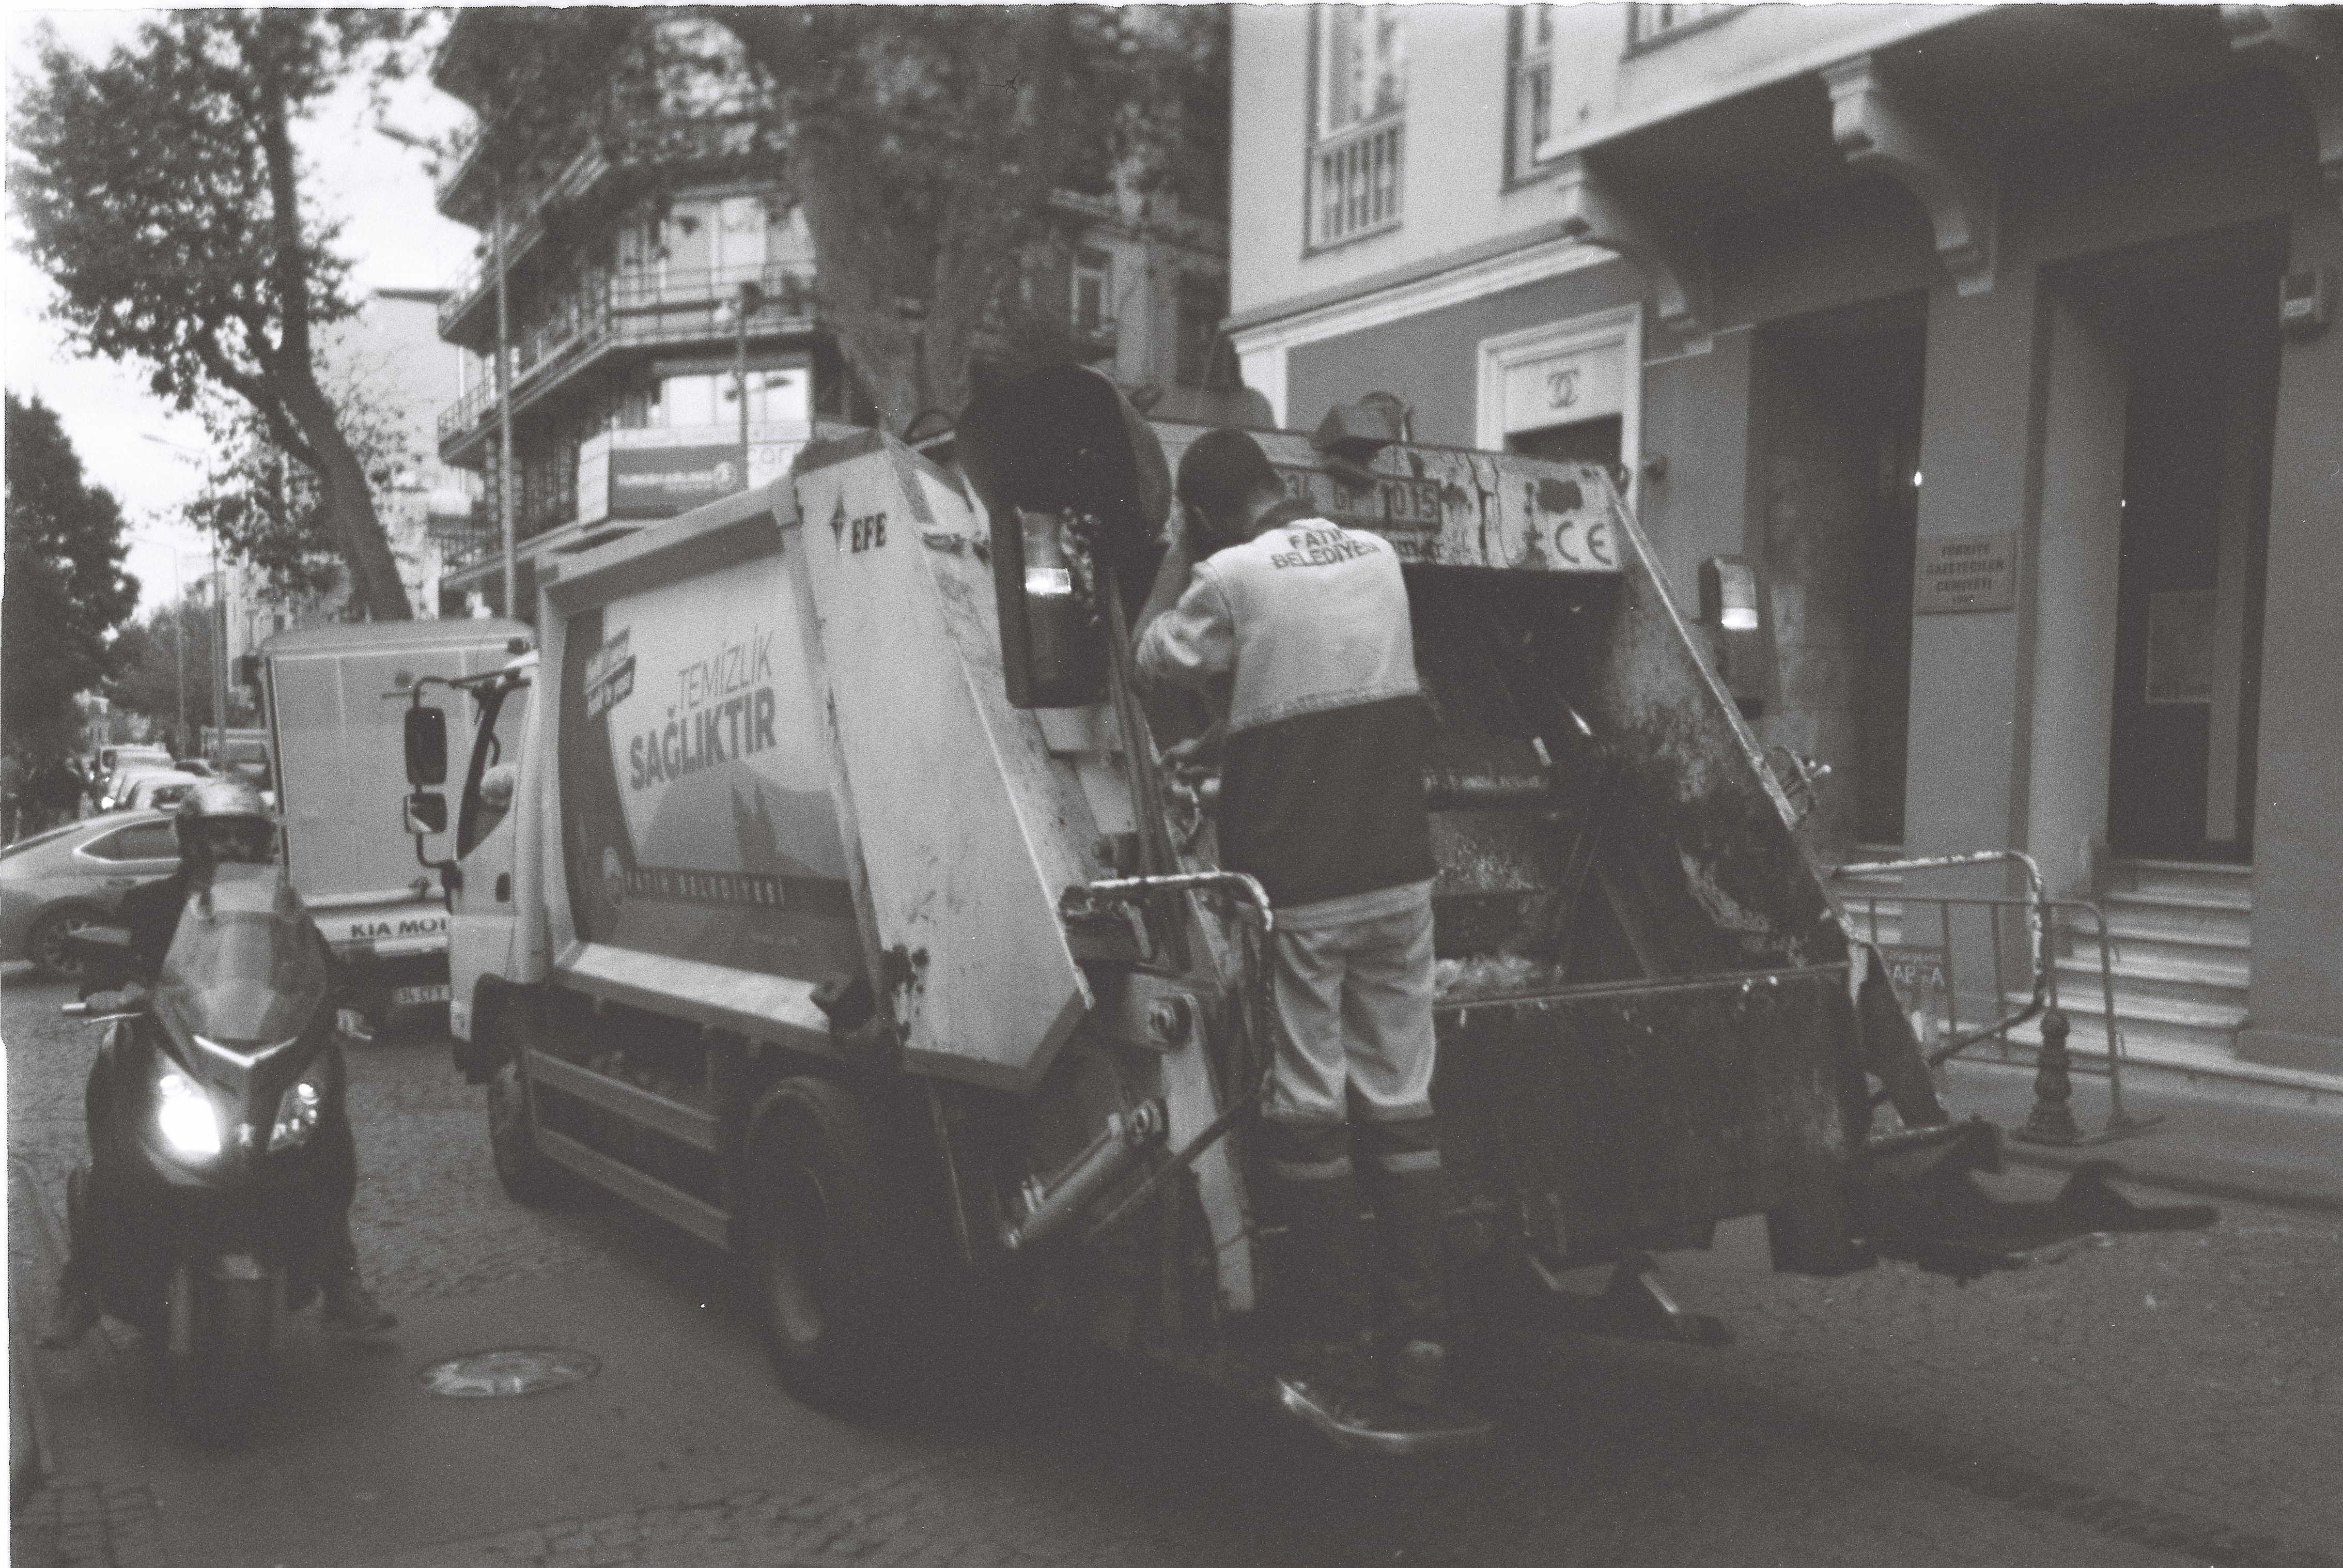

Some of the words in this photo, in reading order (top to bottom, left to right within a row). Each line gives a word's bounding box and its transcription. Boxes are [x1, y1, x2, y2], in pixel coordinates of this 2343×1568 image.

[851, 511, 887, 554] EFE
[1555, 521, 1612, 565] CE
[678, 623, 774, 710] TEMİZLİK
[630, 686, 777, 790] SAĞLIKTIR
[350, 922, 391, 938] KIA
